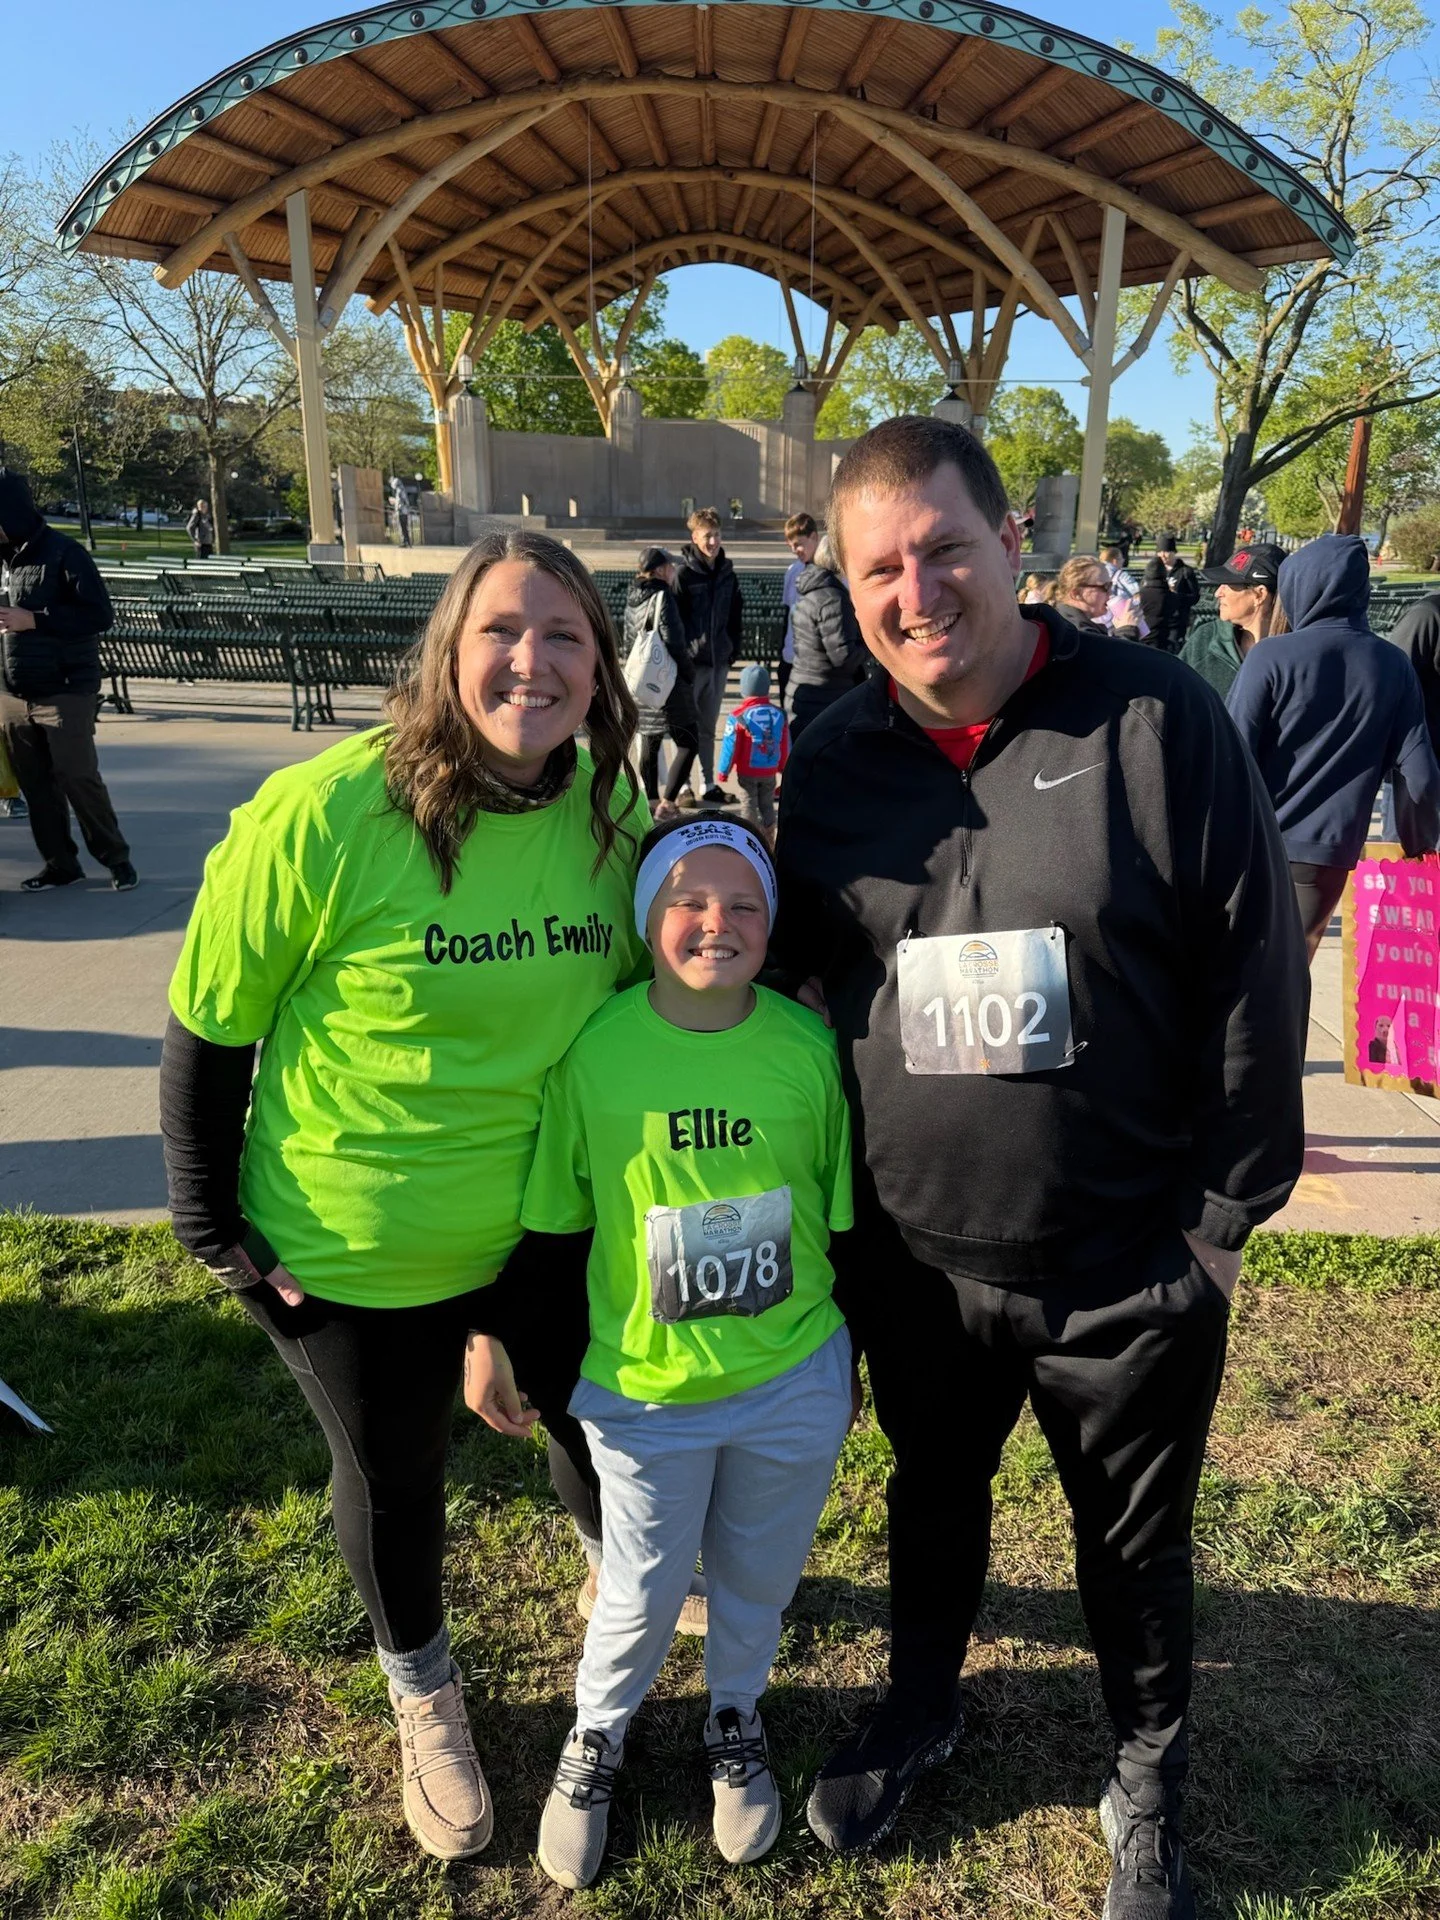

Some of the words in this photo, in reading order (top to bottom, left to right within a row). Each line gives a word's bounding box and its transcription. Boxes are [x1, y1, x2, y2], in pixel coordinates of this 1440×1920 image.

[1363, 873, 1397, 895] say
[424, 918, 534, 965] Coach
[543, 912, 613, 959] Emily
[1369, 904, 1435, 931] SWEAR
[923, 991, 1050, 1048] 1102
[1408, 1012, 1419, 1028] a
[668, 1107, 753, 1151] Ellie
[666, 1240, 779, 1302] 1078
